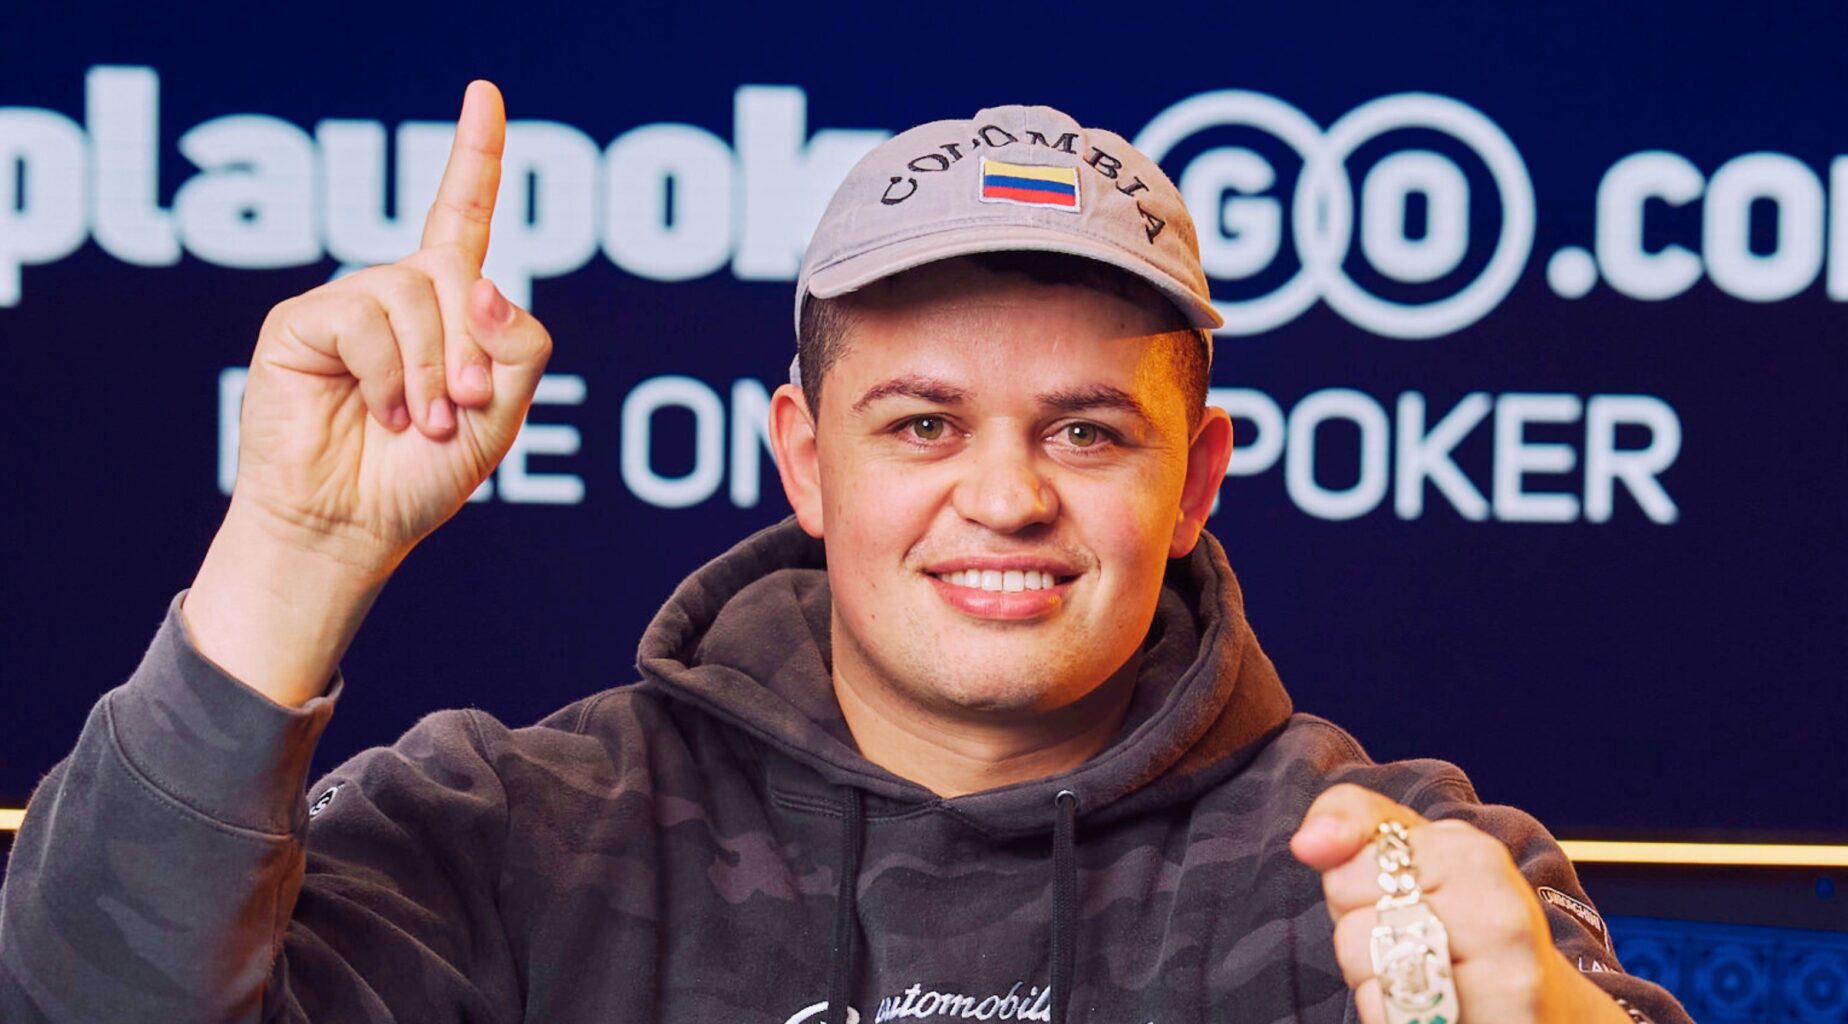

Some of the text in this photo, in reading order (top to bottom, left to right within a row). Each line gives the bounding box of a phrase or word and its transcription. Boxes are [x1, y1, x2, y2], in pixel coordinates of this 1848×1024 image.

[881, 124, 1166, 244] COLOMBIA
[1205, 387, 1682, 524] POKER
[875, 981, 1052, 1024] automobil
